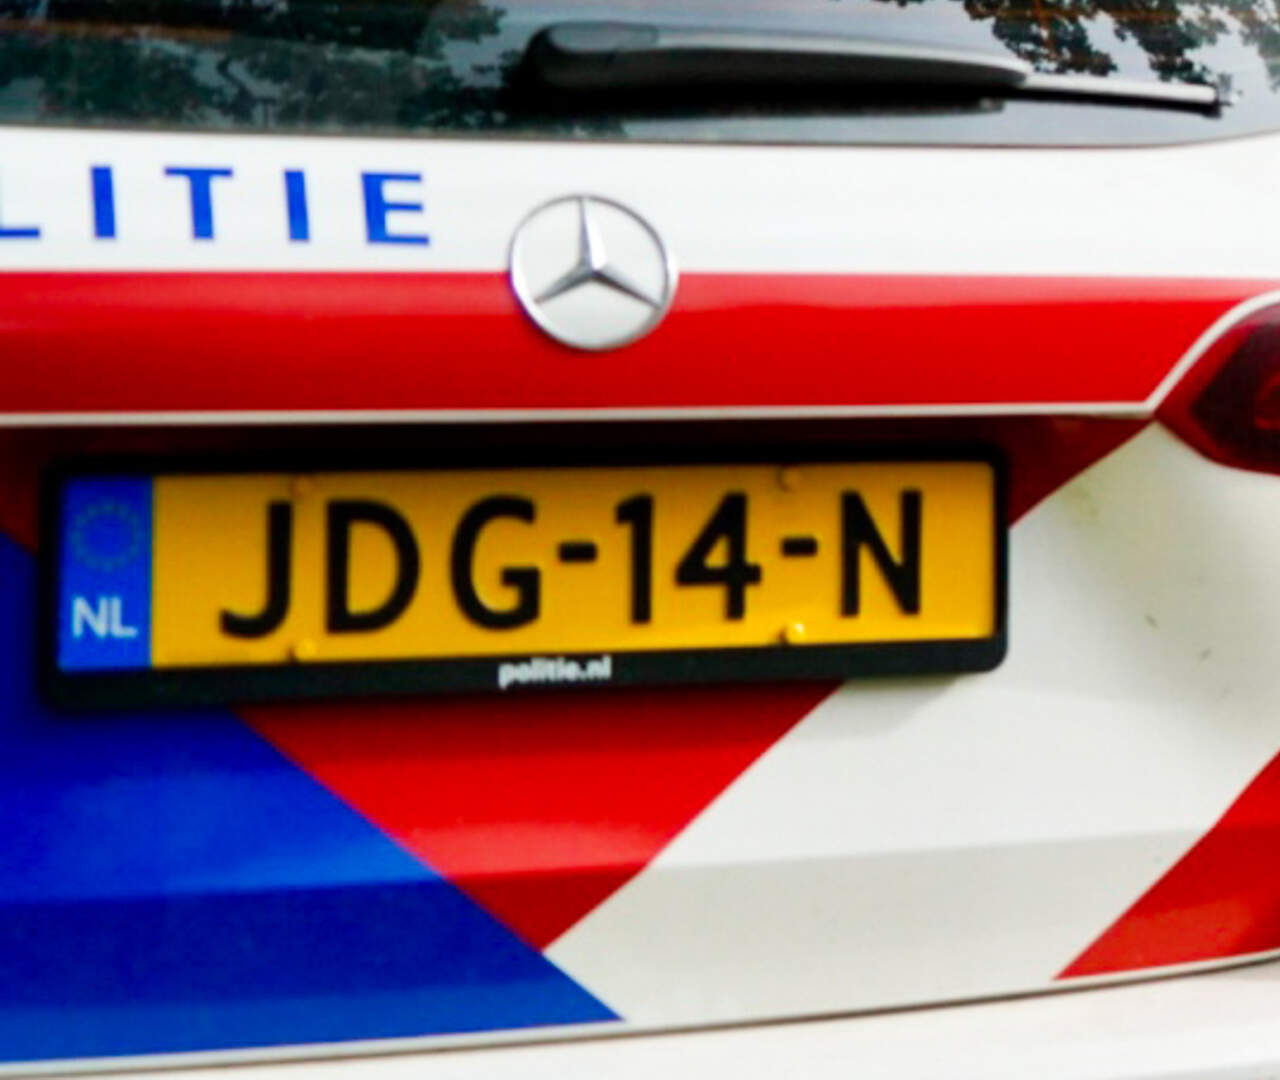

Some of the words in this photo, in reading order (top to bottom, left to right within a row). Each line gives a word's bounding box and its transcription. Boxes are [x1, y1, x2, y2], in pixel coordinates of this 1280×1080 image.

[218, 488, 924, 639] JDG-14-N
[74, 597, 138, 638] NL
[498, 654, 612, 689] politie.nl
